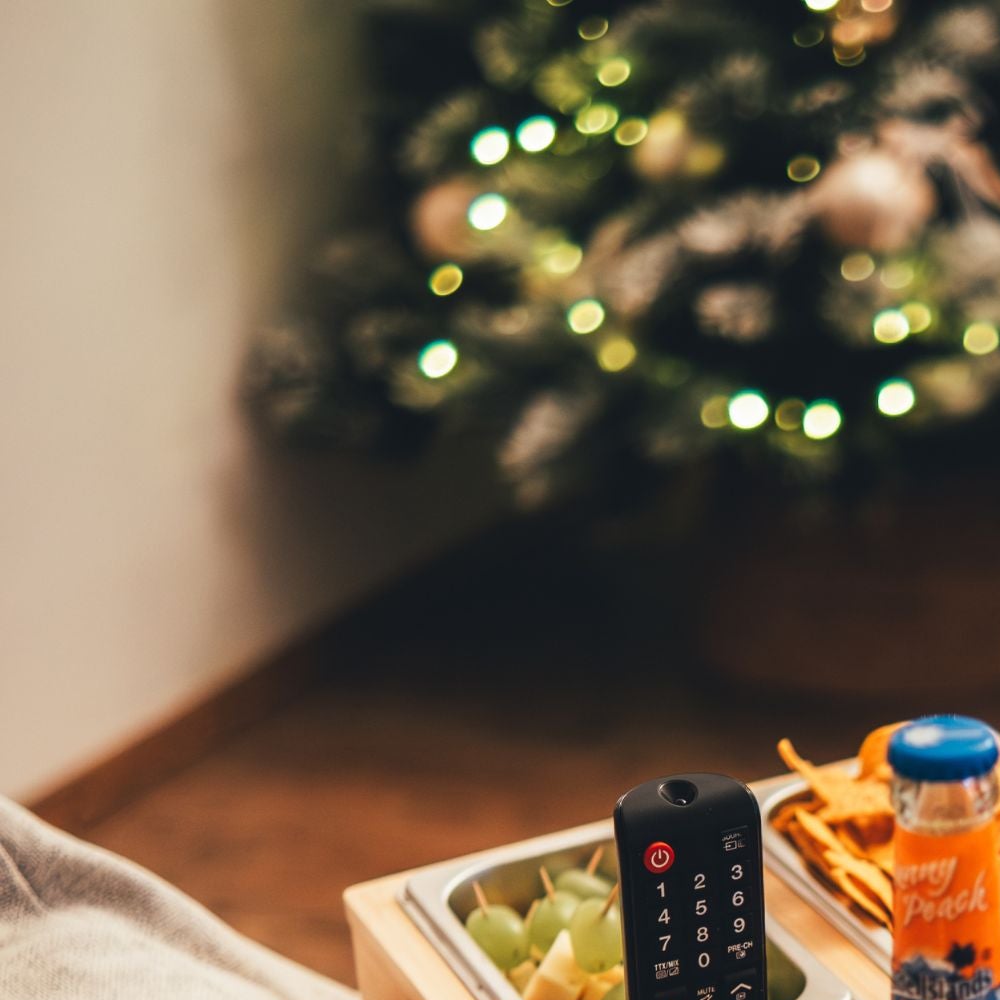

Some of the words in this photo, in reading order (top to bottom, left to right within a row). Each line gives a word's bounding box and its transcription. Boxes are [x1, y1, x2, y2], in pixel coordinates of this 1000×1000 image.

[731, 864, 743, 880] 3
[694, 873, 706, 889] 2
[656, 882, 665, 897] 1
[732, 891, 744, 906] 6
[695, 899, 707, 916] 5
[658, 908, 671, 924] 4
[733, 917, 745, 933] 9
[696, 926, 709, 942] 8
[659, 935, 671, 951] 7
[727, 941, 753, 953] PRE-CH
[654, 959, 680, 971] TTX/MIX
[698, 952, 710, 968] 0
[697, 986, 716, 996] MUTE
